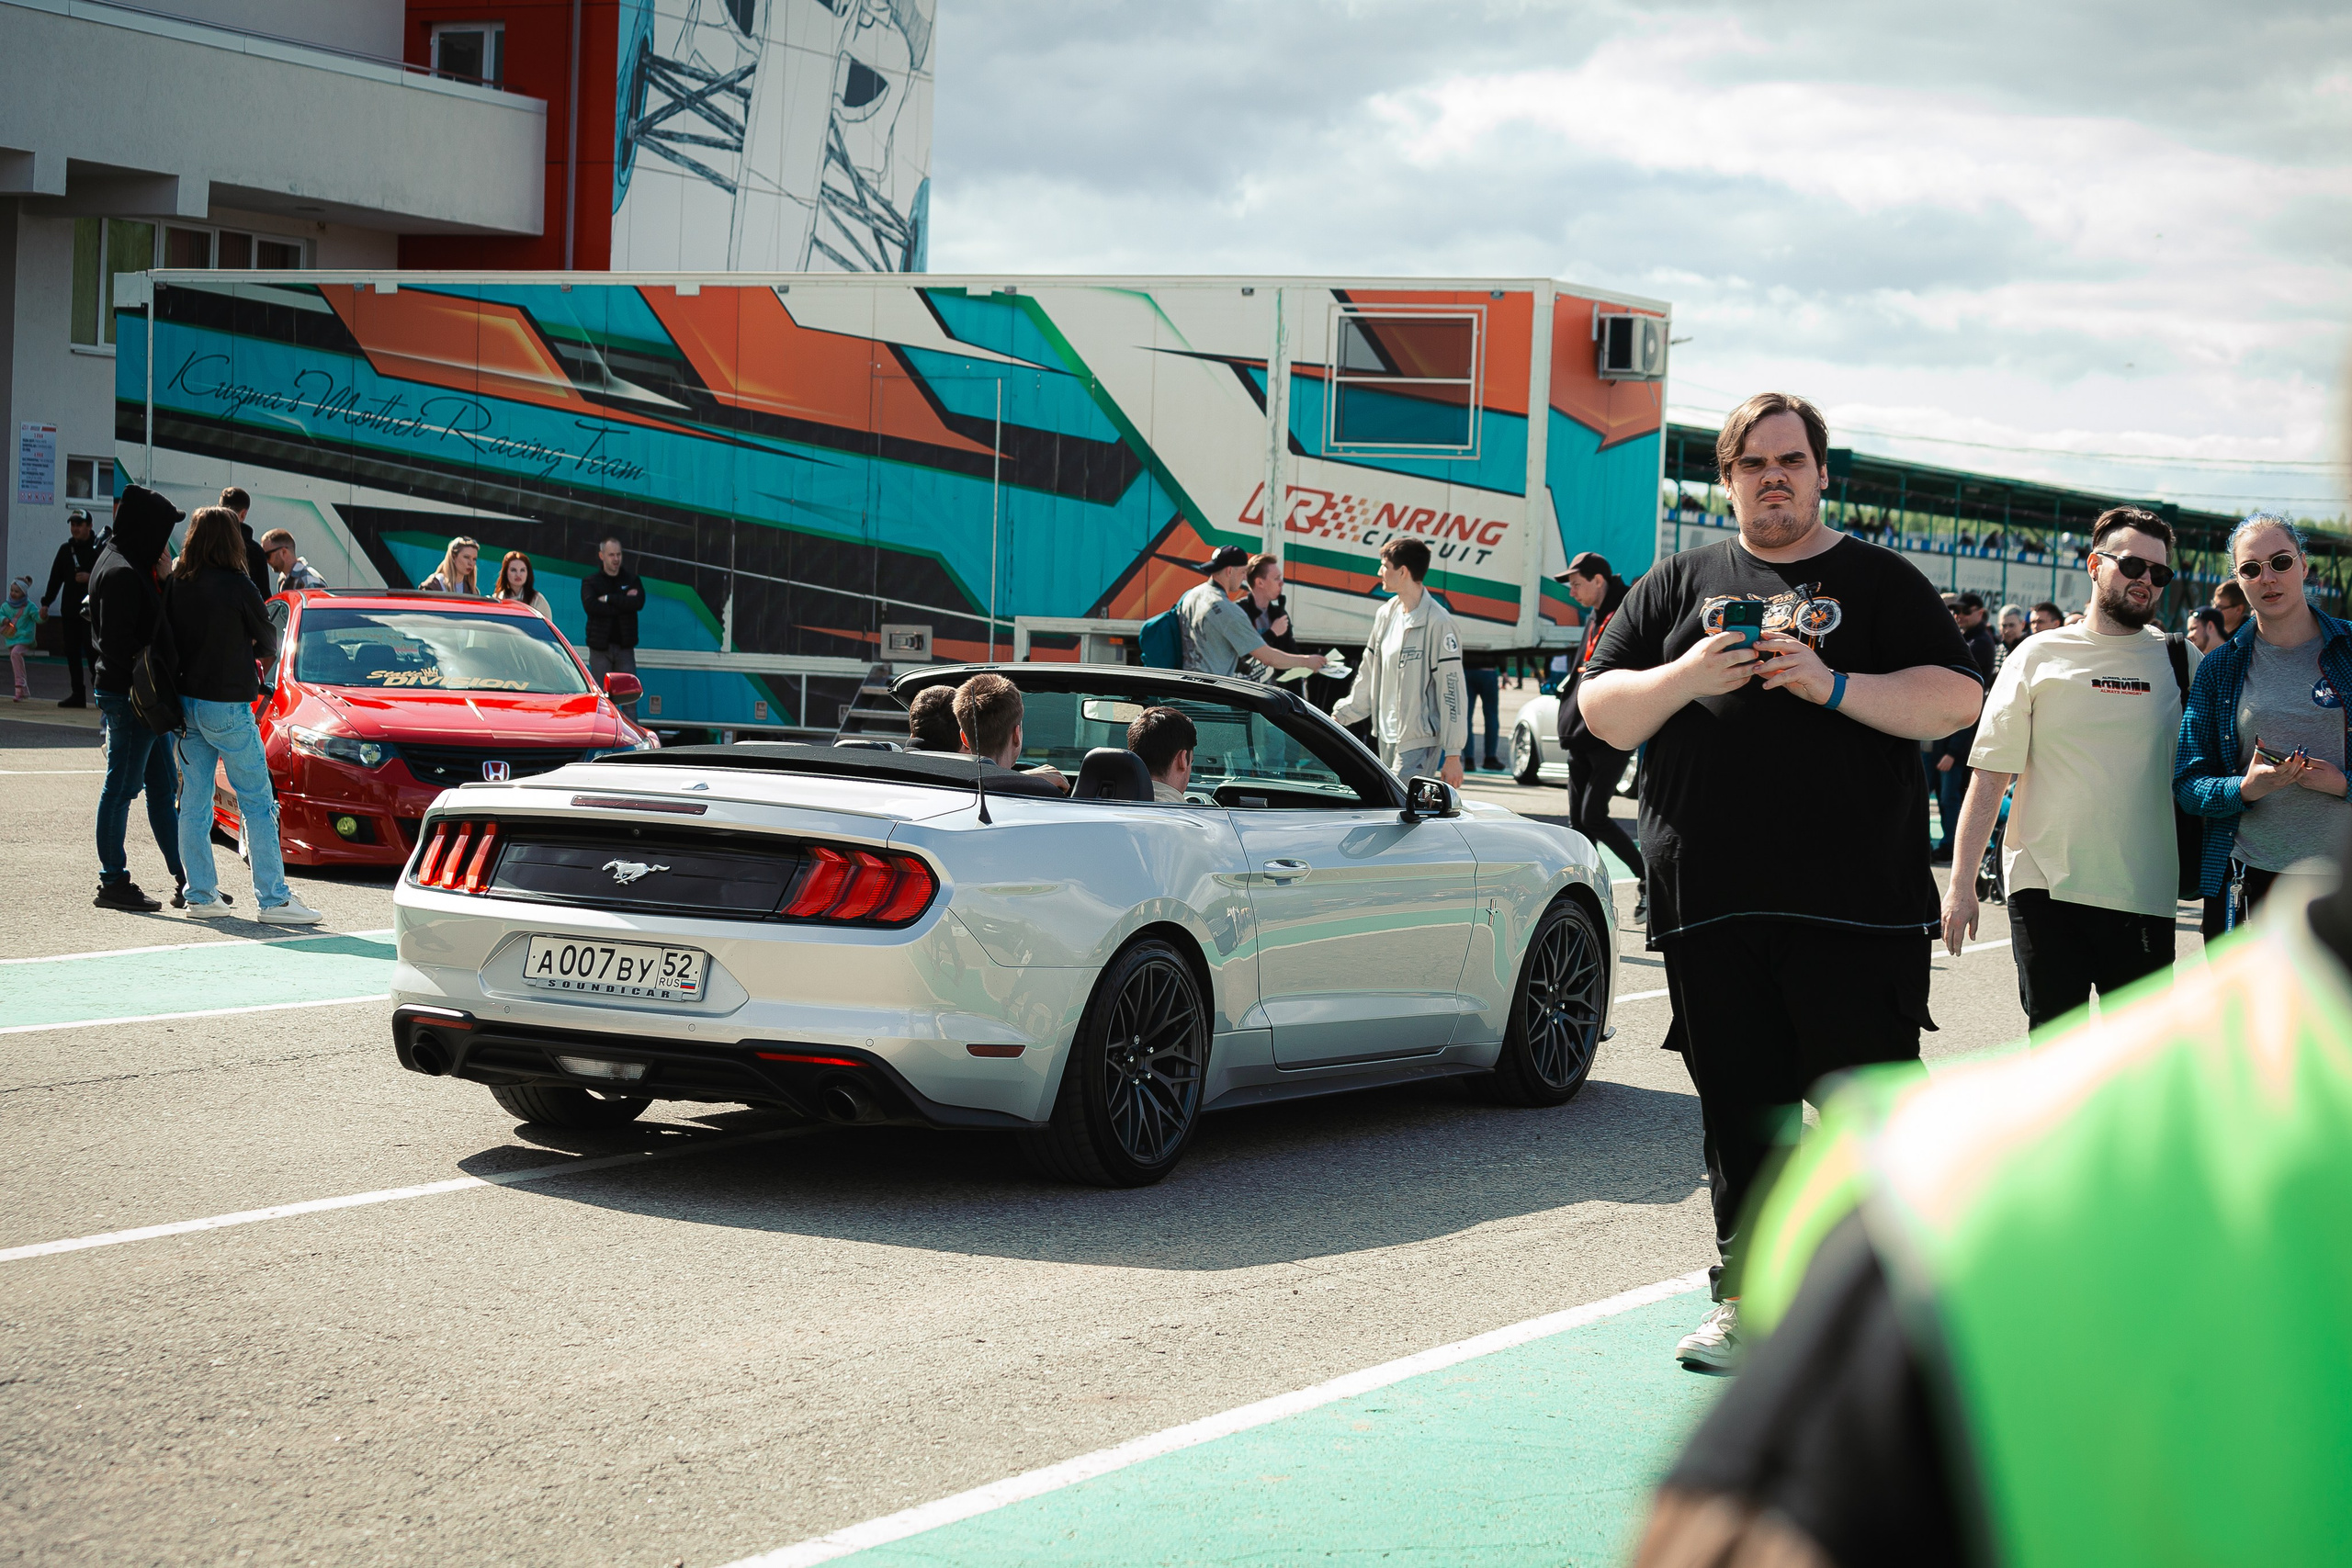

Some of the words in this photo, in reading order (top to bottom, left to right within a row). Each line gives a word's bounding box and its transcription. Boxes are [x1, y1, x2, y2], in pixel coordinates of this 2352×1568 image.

[293, 368, 432, 438] Mother
[420, 396, 565, 481] Racing
[574, 419, 645, 481] Team
[1372, 502, 1510, 547] NRING
[1362, 530, 1493, 565] CIUIT
[382, 675, 530, 691] DIVISION
[662, 952, 693, 978] 52
[548, 979, 671, 998] SOUNDICAR
[658, 976, 680, 988] RUS
